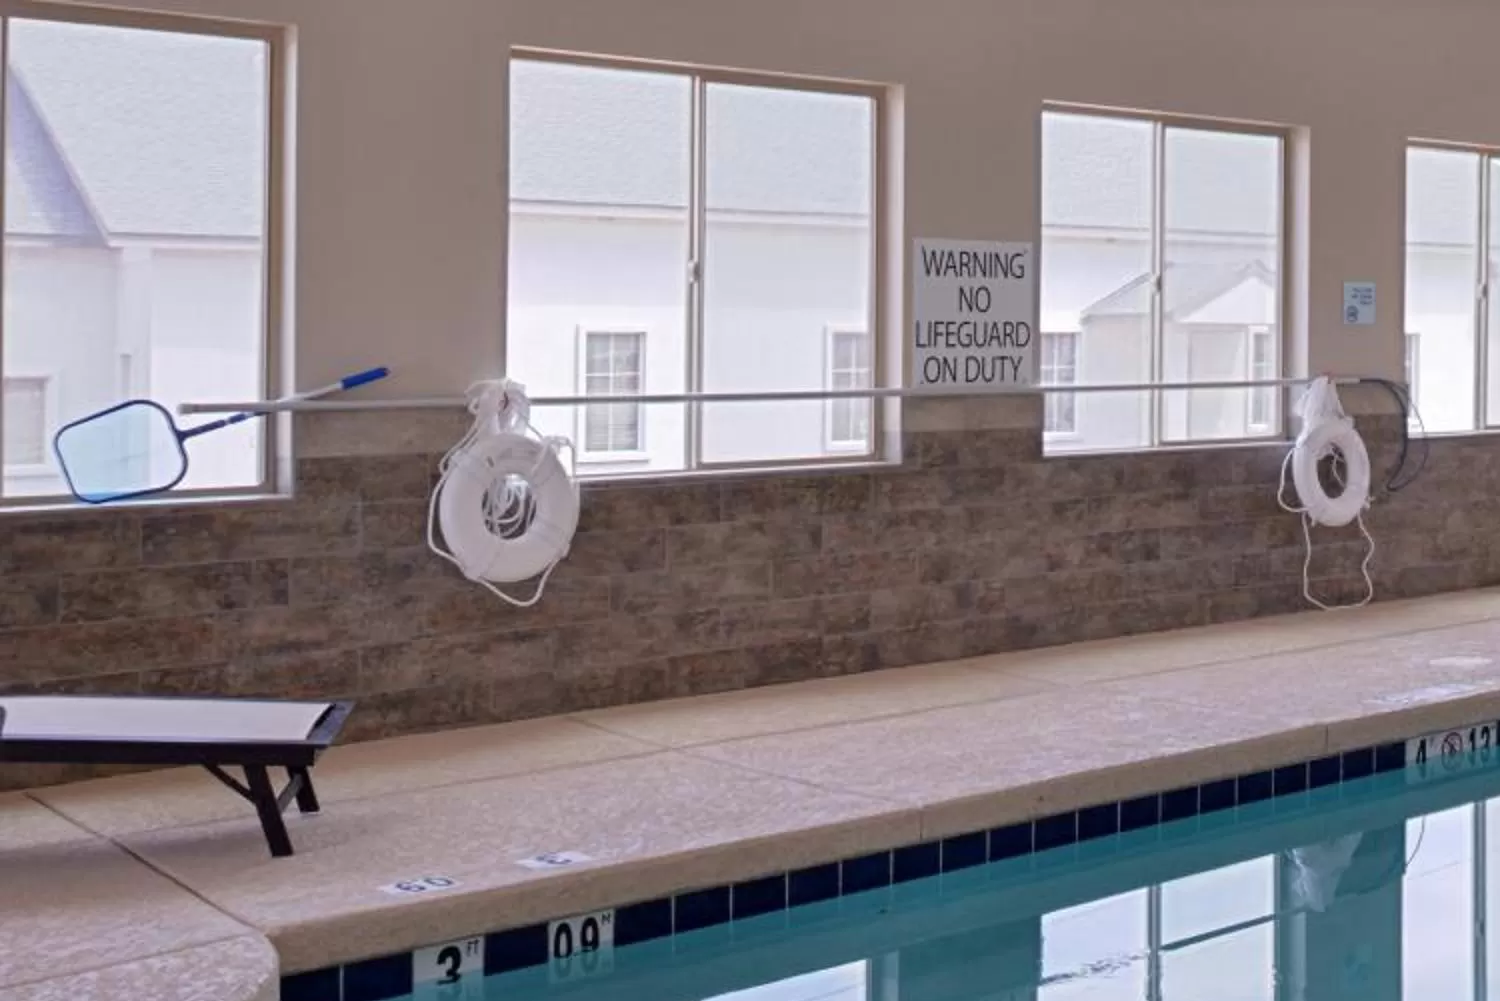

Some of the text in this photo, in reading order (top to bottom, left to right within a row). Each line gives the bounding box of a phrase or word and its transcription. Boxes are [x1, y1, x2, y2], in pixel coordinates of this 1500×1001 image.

[922, 246, 1026, 279] WARNING
[959, 285, 991, 313] NO
[915, 320, 1031, 348] LIFEGUARD
[923, 355, 1023, 384] ON DUTY
[436, 945, 461, 985] 3
